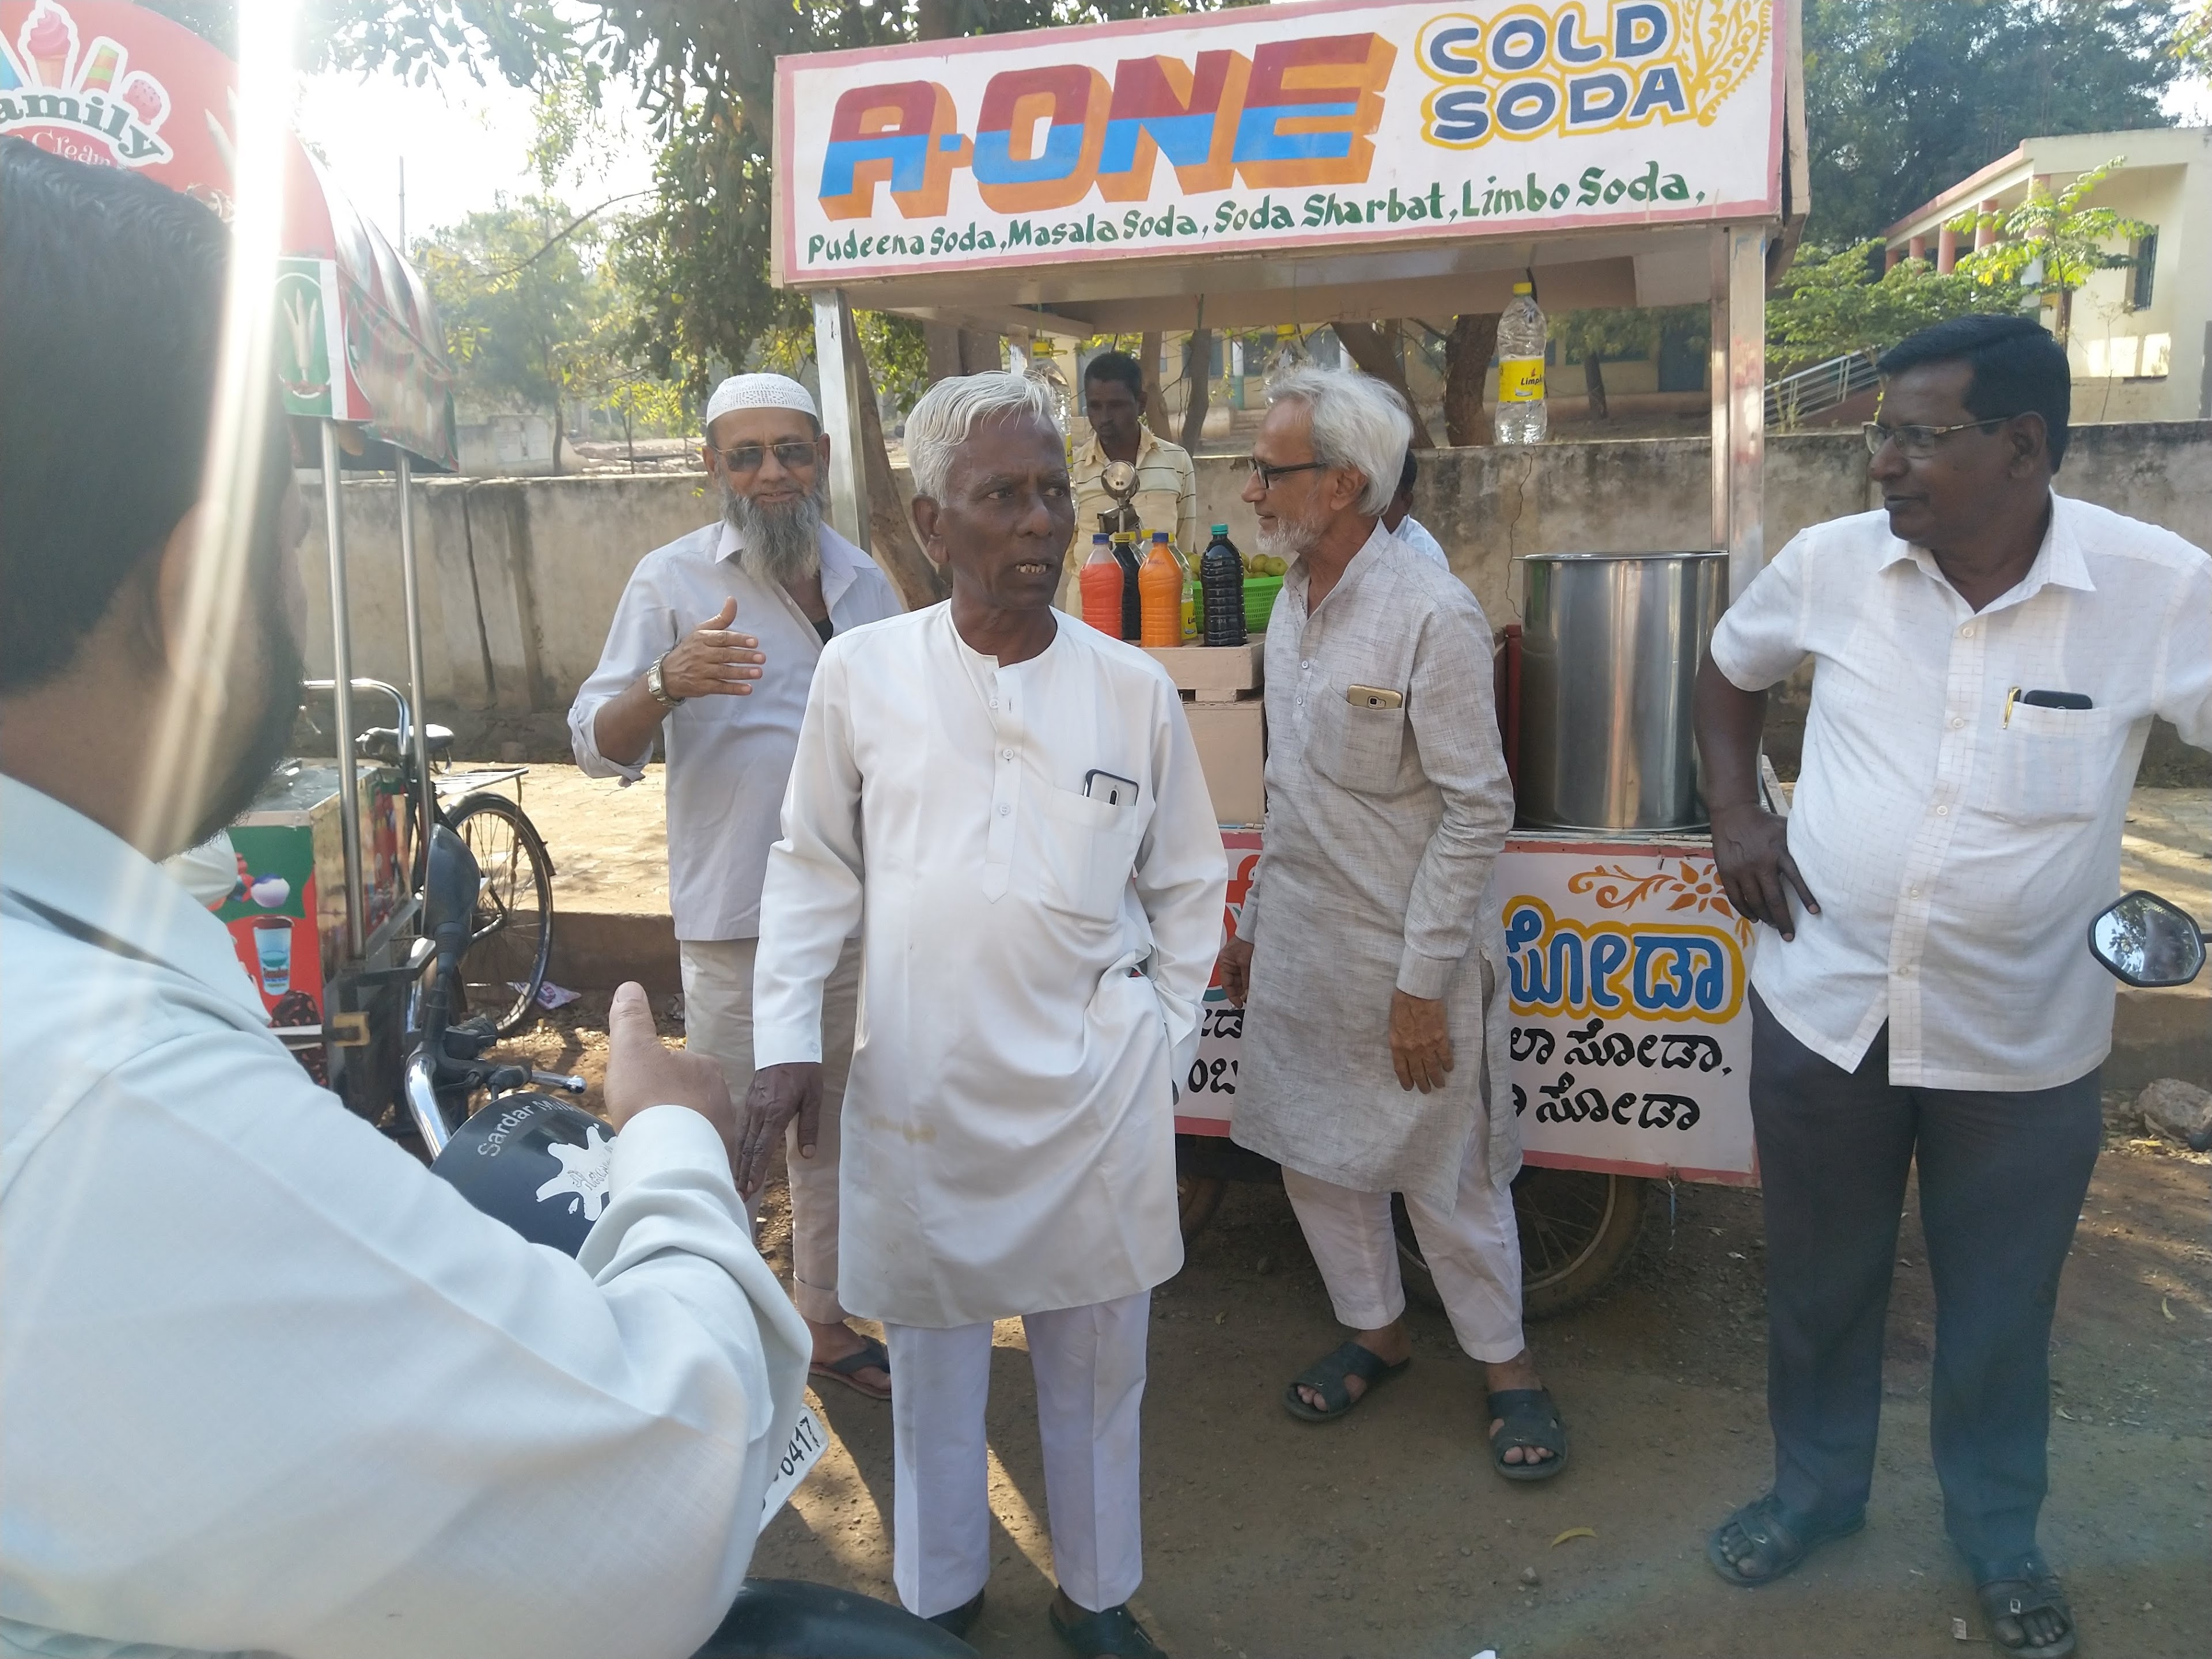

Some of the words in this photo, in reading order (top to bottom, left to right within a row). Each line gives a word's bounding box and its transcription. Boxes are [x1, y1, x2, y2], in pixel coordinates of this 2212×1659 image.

[1430, 4, 1668, 75] COLD
[0, 94, 165, 159] amily
[818, 32, 1397, 221] A-ONE
[1433, 67, 1685, 141] SODA
[808, 229, 925, 264] Pudeena
[1008, 213, 1118, 246] Masala
[1213, 193, 1294, 233] Soda
[1301, 181, 1459, 229] Sharbat,
[1461, 175, 1570, 217] Limbo
[477, 1105, 535, 1157] Sardar
